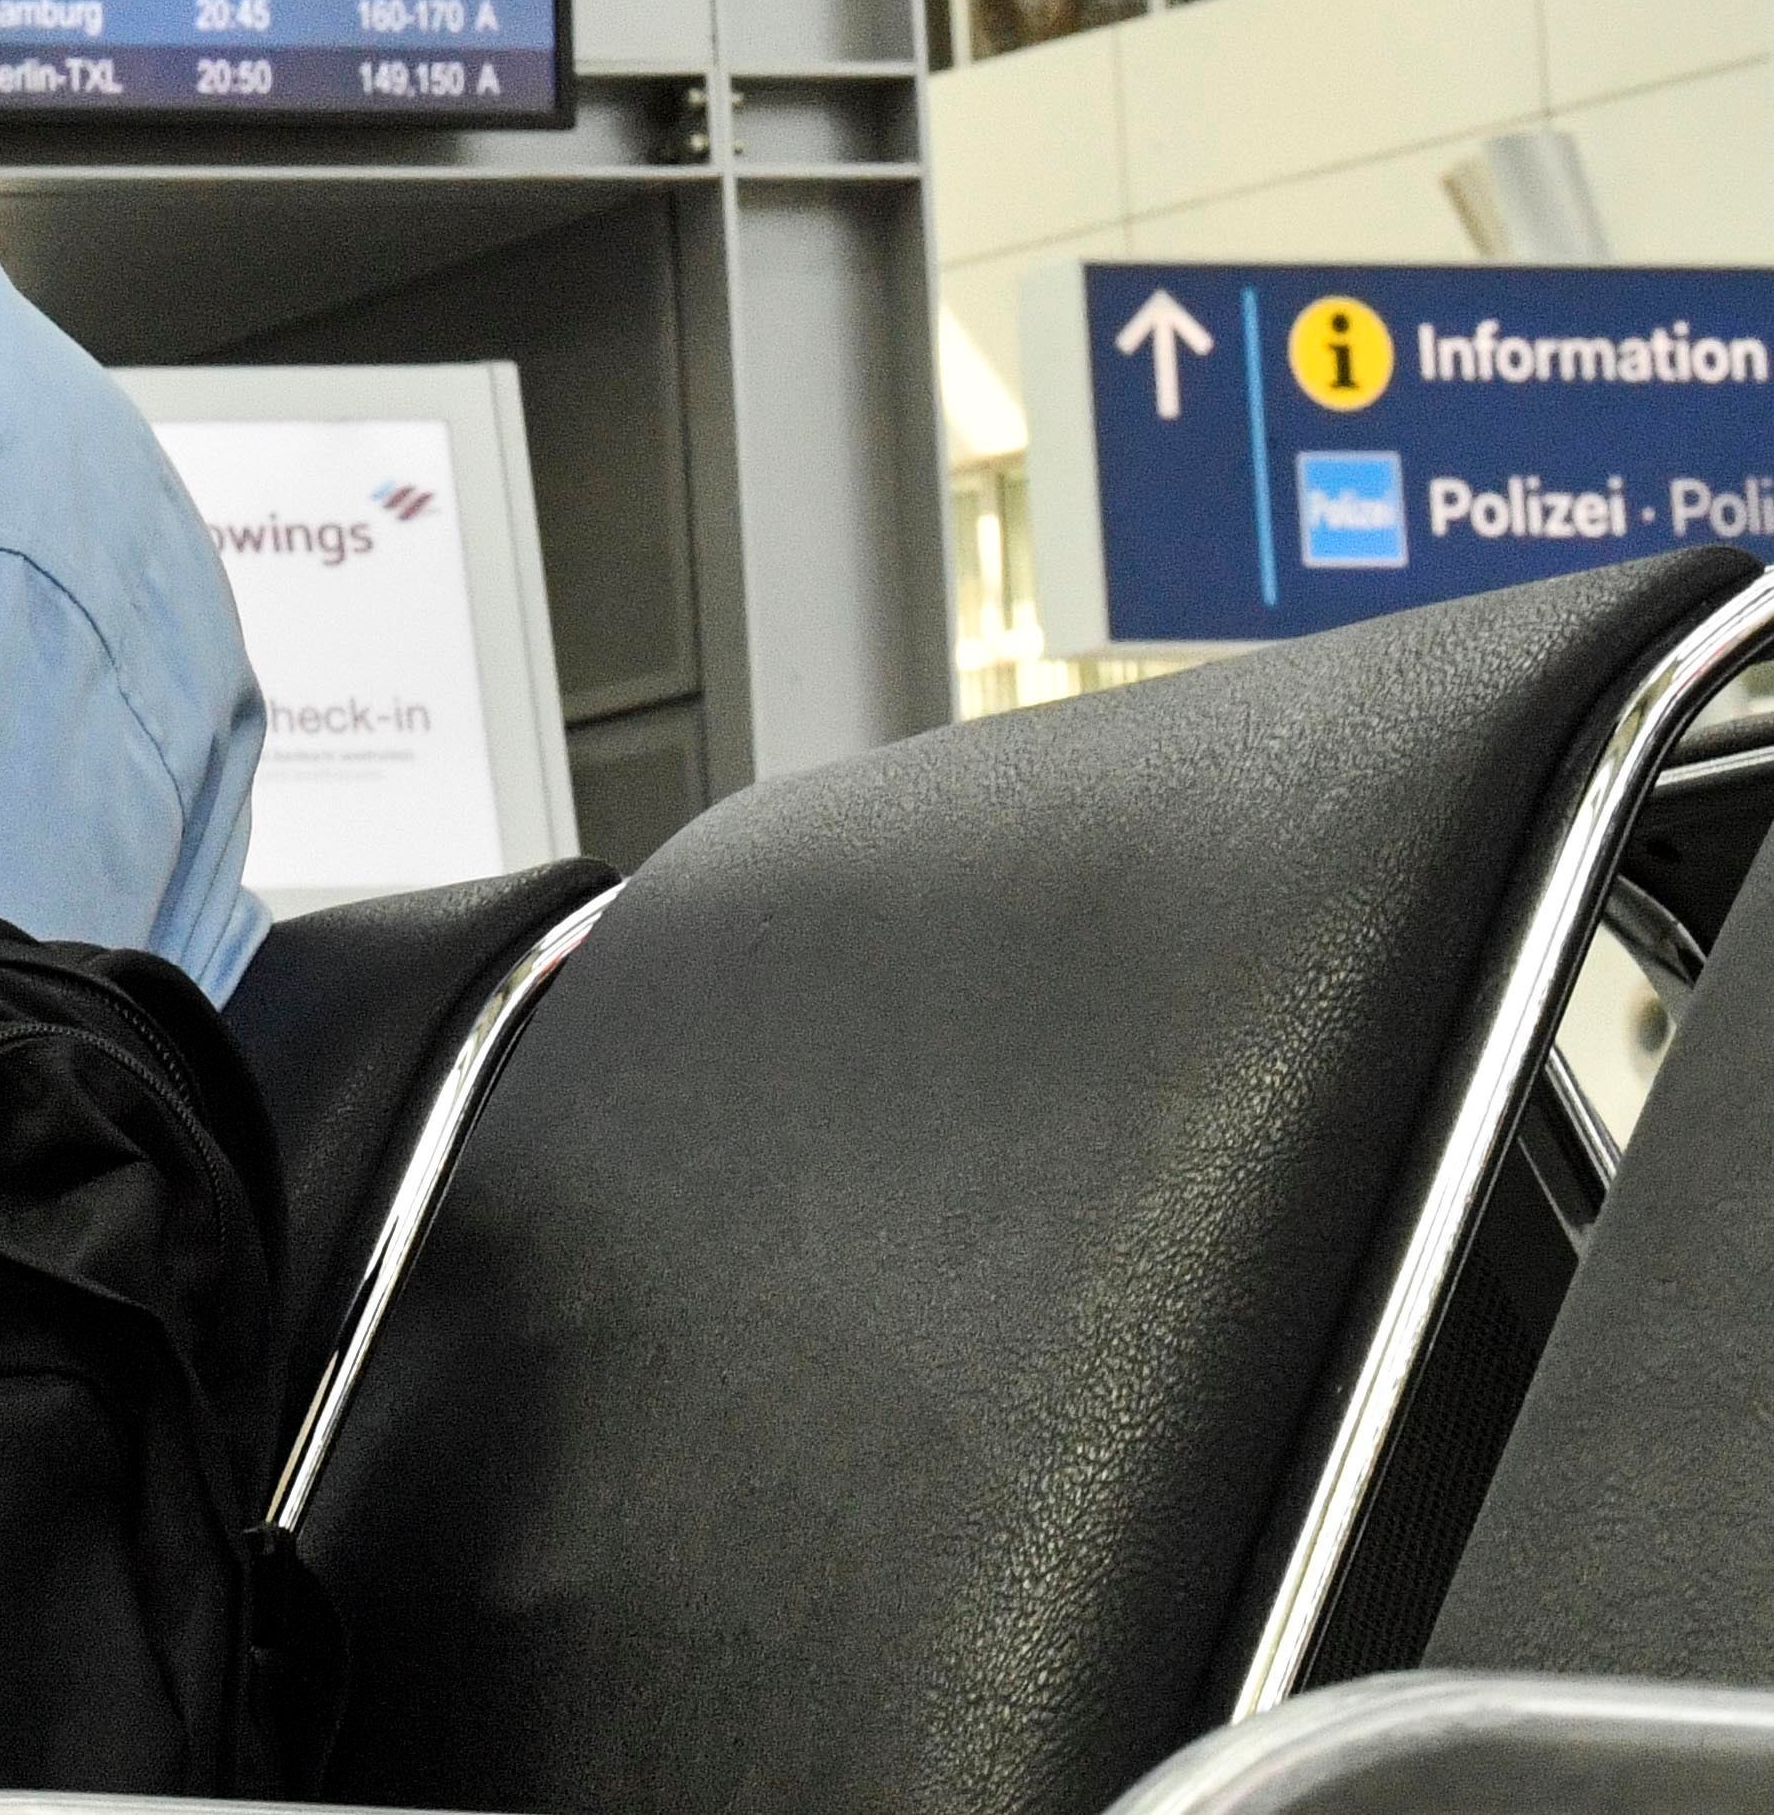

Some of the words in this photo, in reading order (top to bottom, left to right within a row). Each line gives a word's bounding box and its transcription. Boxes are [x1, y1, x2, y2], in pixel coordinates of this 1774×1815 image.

[1418, 319, 1768, 384] Information
[1429, 476, 1627, 538] Polizei
[209, 512, 373, 566] wings
[270, 698, 430, 733] heck-in
